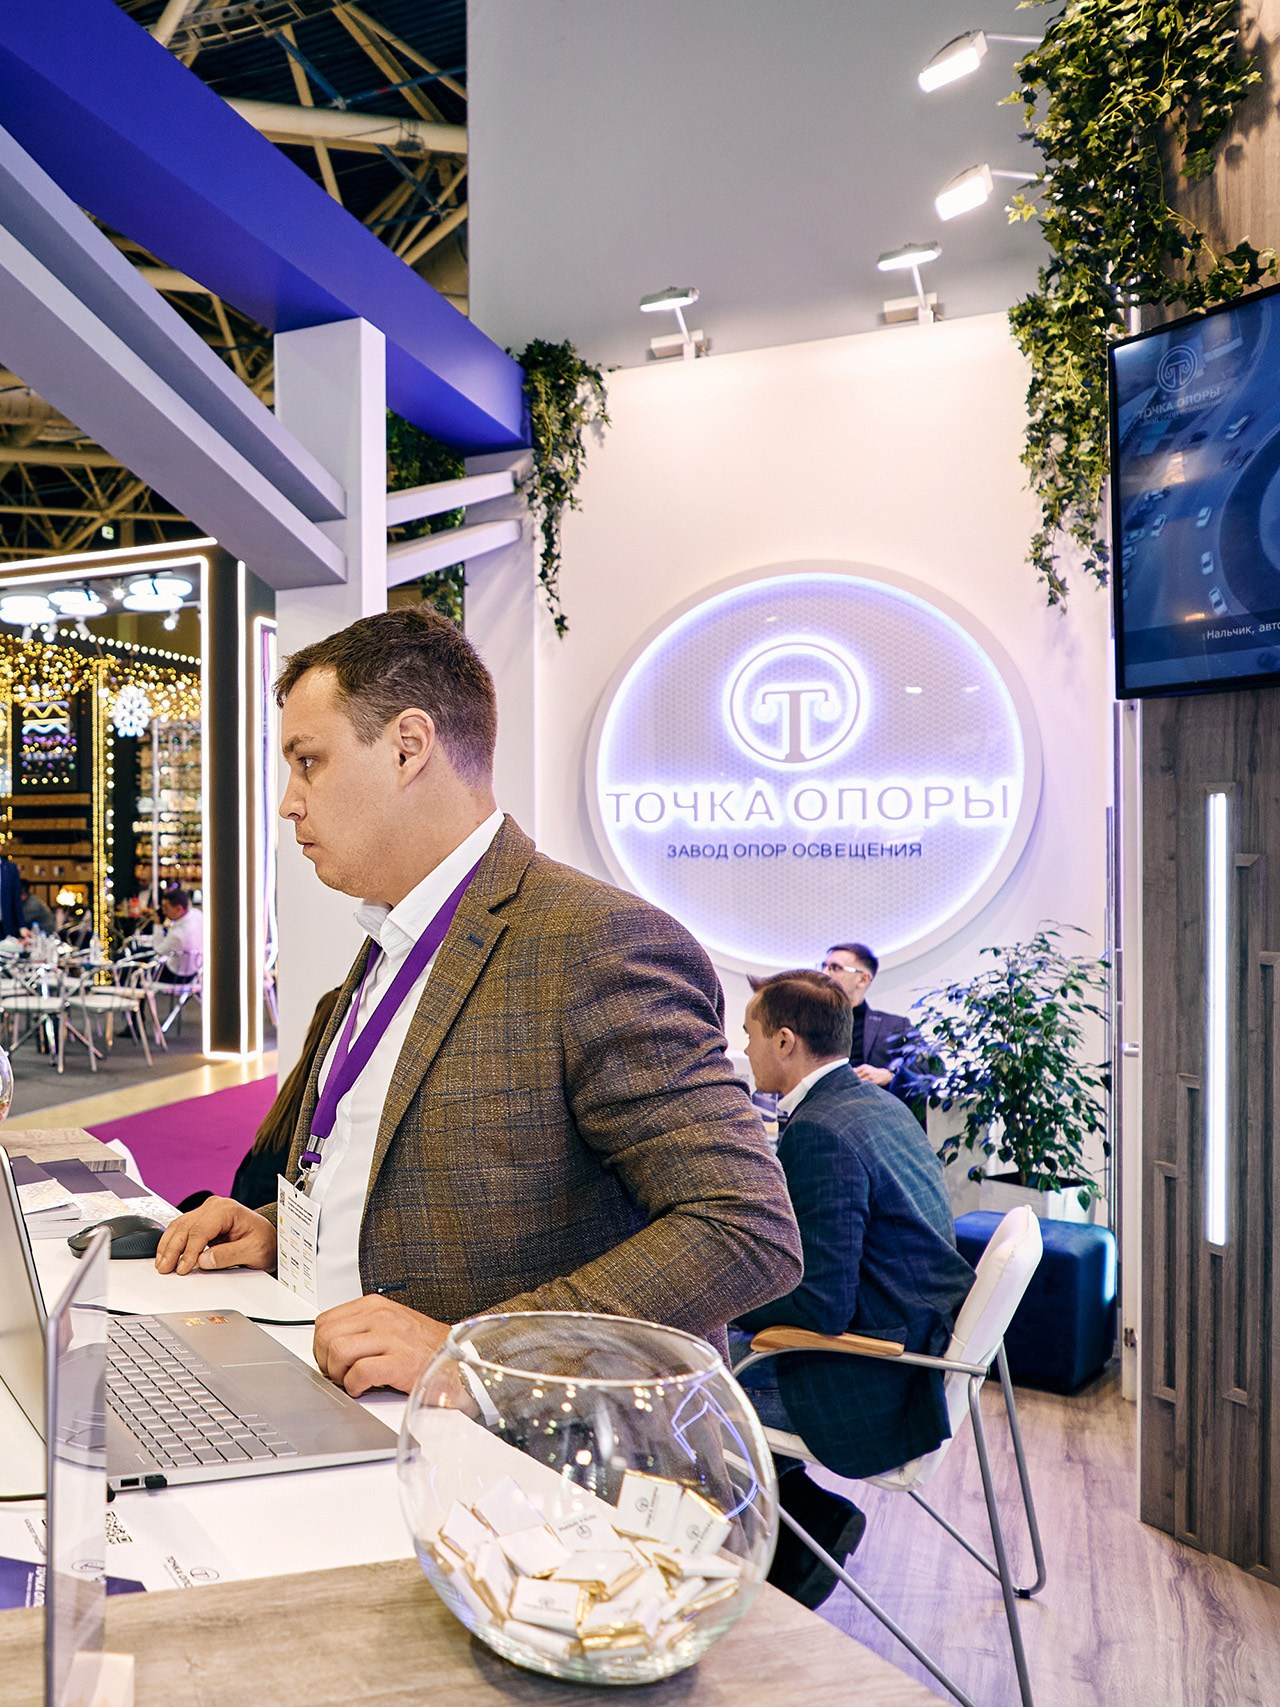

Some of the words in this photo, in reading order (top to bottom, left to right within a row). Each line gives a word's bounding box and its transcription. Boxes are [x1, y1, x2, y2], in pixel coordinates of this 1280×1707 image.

[1206, 626, 1255, 640] Нальчик,
[606, 790, 775, 823] ТОЧКА
[793, 785, 1008, 822] ОПОРЫ
[667, 843, 729, 860] ЗАВОД
[733, 843, 787, 859] ОПОР
[792, 842, 922, 860] ОСВЕЩЕНИЯ
